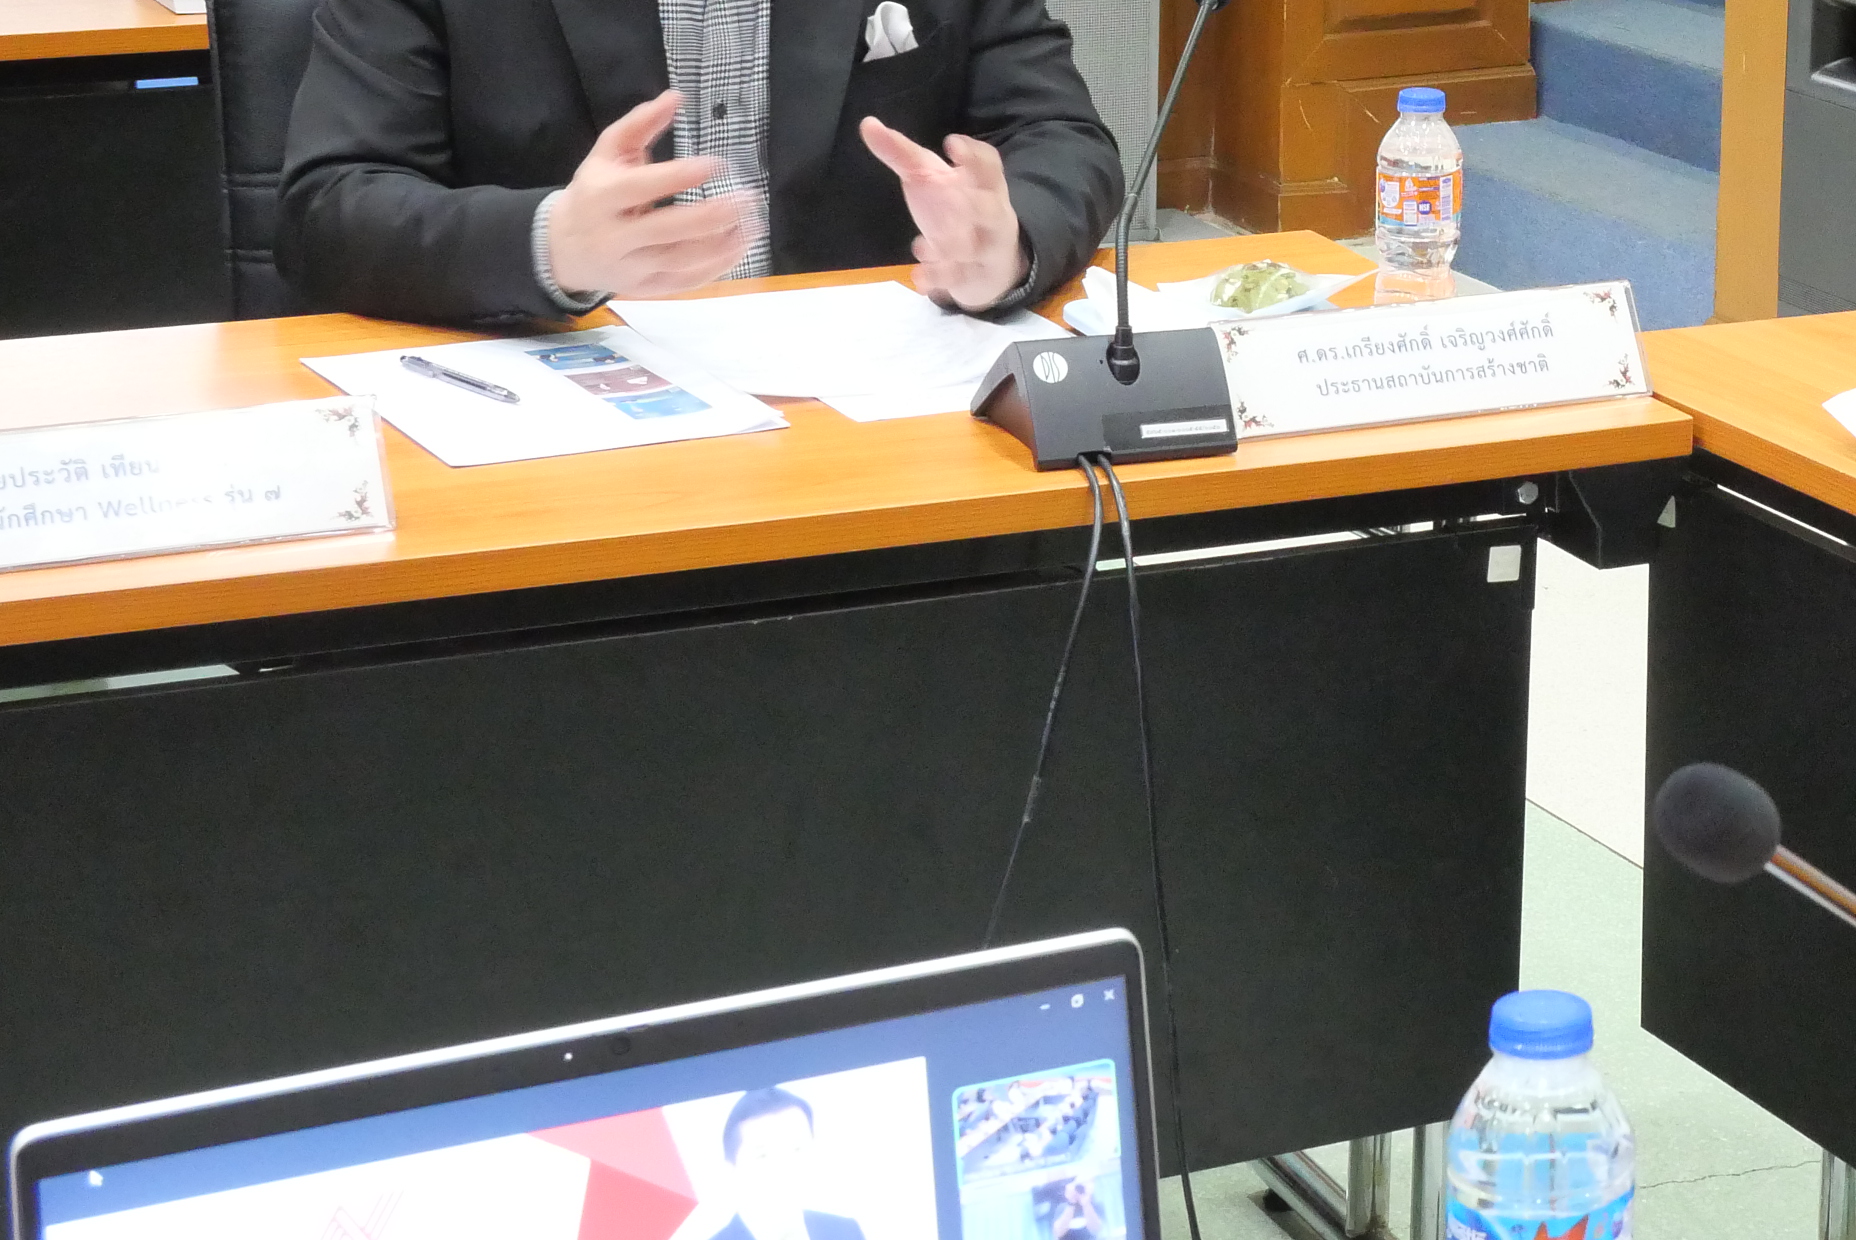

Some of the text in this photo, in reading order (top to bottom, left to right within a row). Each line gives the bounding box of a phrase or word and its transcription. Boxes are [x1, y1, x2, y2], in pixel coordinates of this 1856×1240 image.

[1297, 311, 1555, 365] ศ.ดร.เกรียงศักดิ์ เจริญวงศ์ศักดิ์
[1315, 354, 1550, 397] ประธานสถาบันการสร้างชาติ
